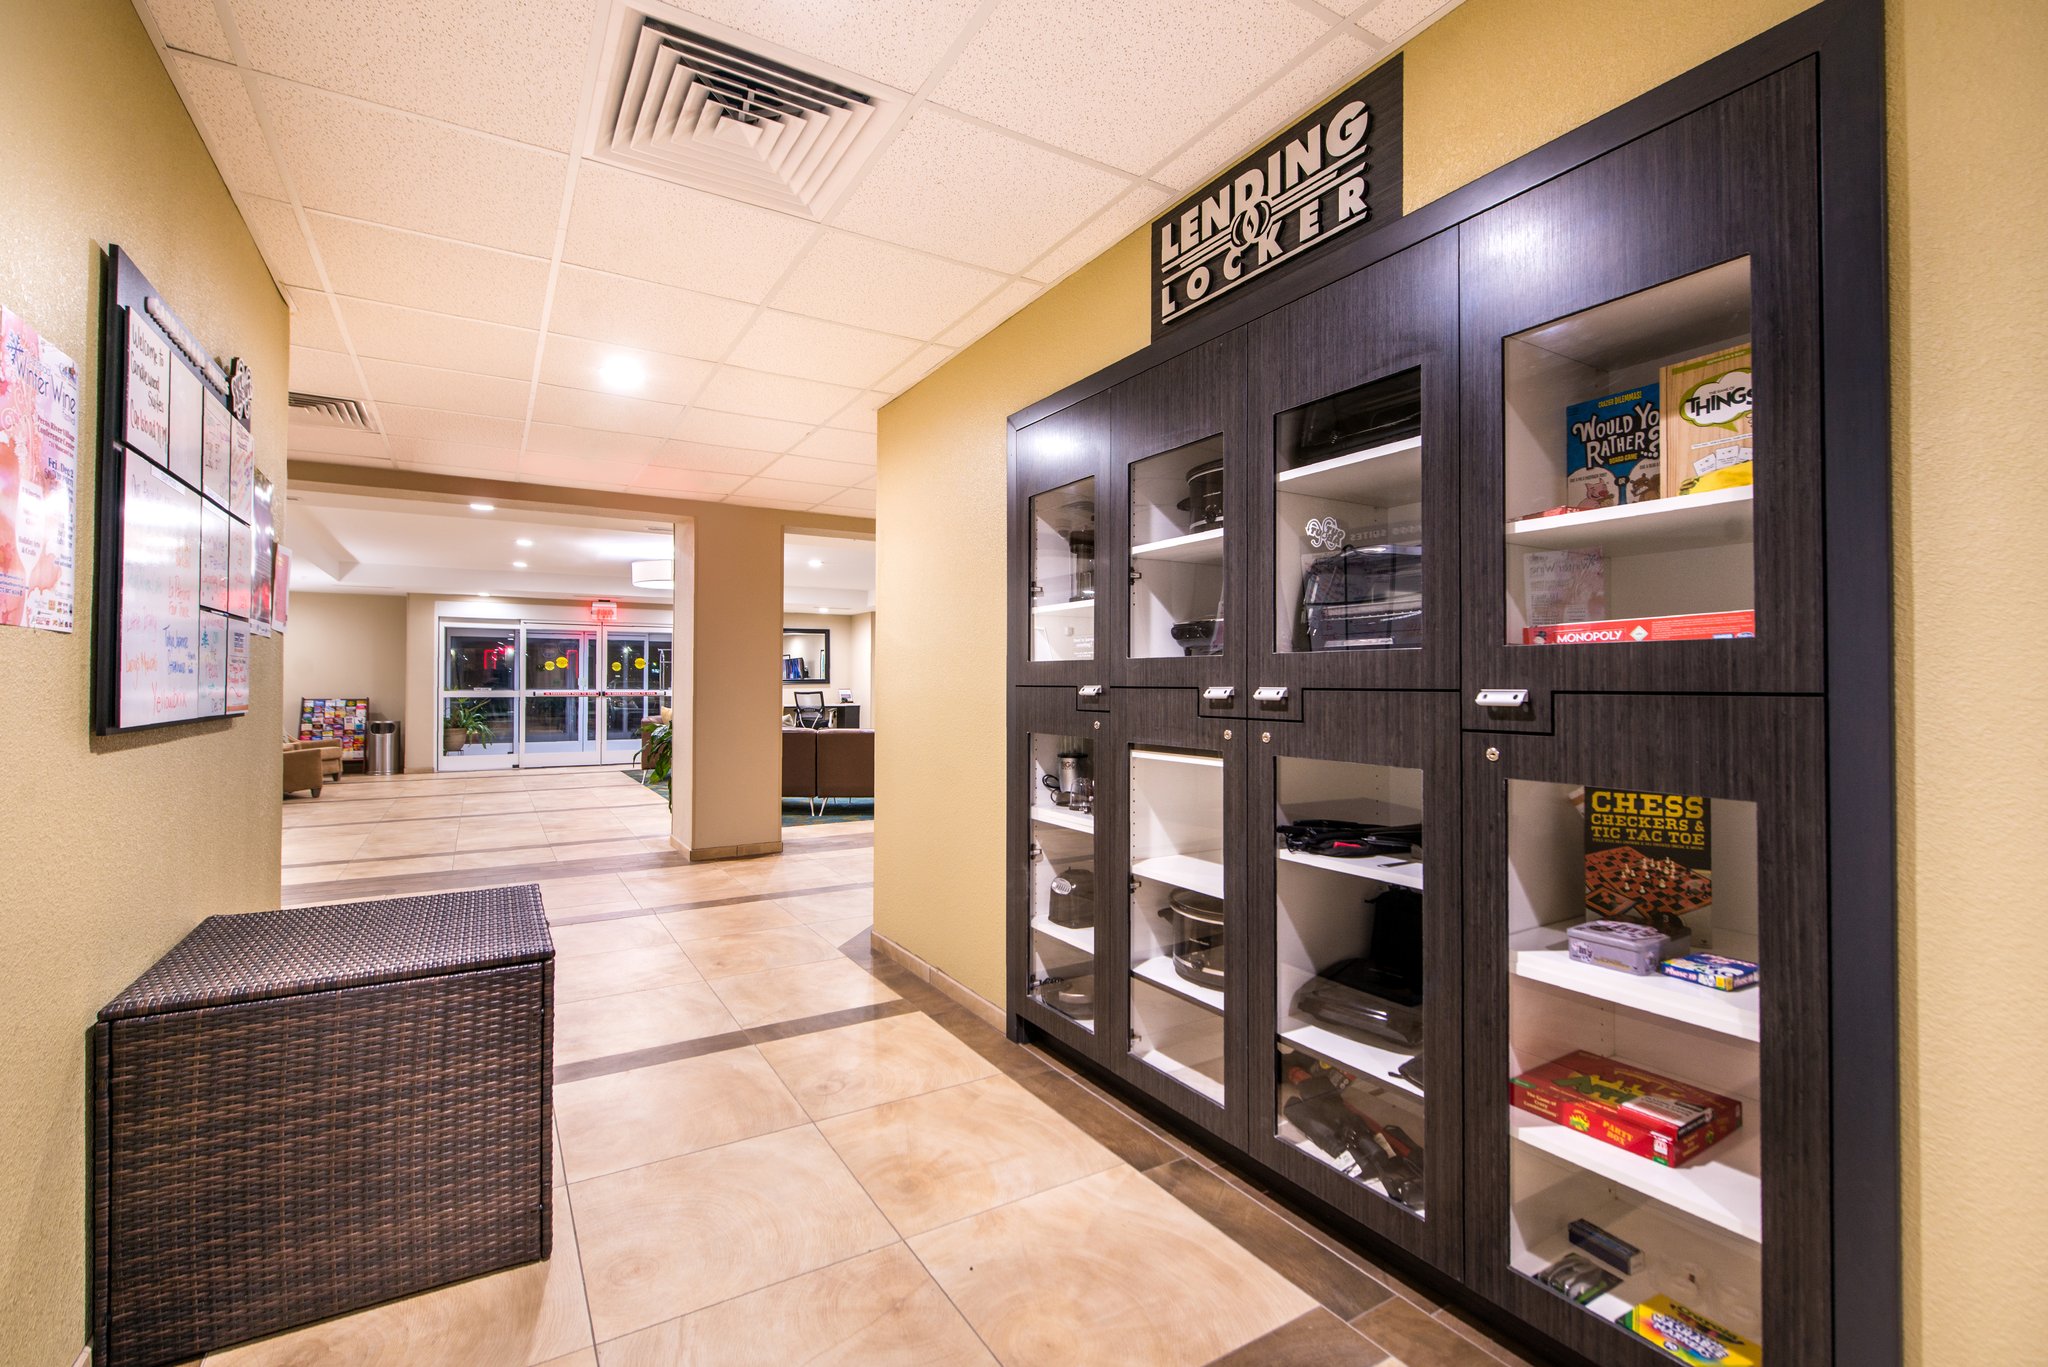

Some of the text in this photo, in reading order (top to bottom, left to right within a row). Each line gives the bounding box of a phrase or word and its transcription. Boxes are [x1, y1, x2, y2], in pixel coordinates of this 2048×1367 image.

[1161, 100, 1369, 266] LENDING
[1161, 176, 1368, 318] LOCKER
[131, 323, 158, 367] Welcome
[16, 354, 49, 397] Winter
[50, 373, 76, 415] Wine
[1572, 402, 1660, 443] WOULD YO
[1586, 431, 1646, 468] RATHER
[1556, 630, 1622, 644] MONOPOLY
[1591, 791, 1705, 819] CHESS
[1591, 813, 1705, 833] CHECKERS &
[1591, 826, 1621, 839] TIC
[1626, 828, 1662, 842] TAC
[1667, 831, 1705, 845] TOE
[1602, 1119, 1634, 1142] PARTY
[1606, 1130, 1626, 1147] BOX
